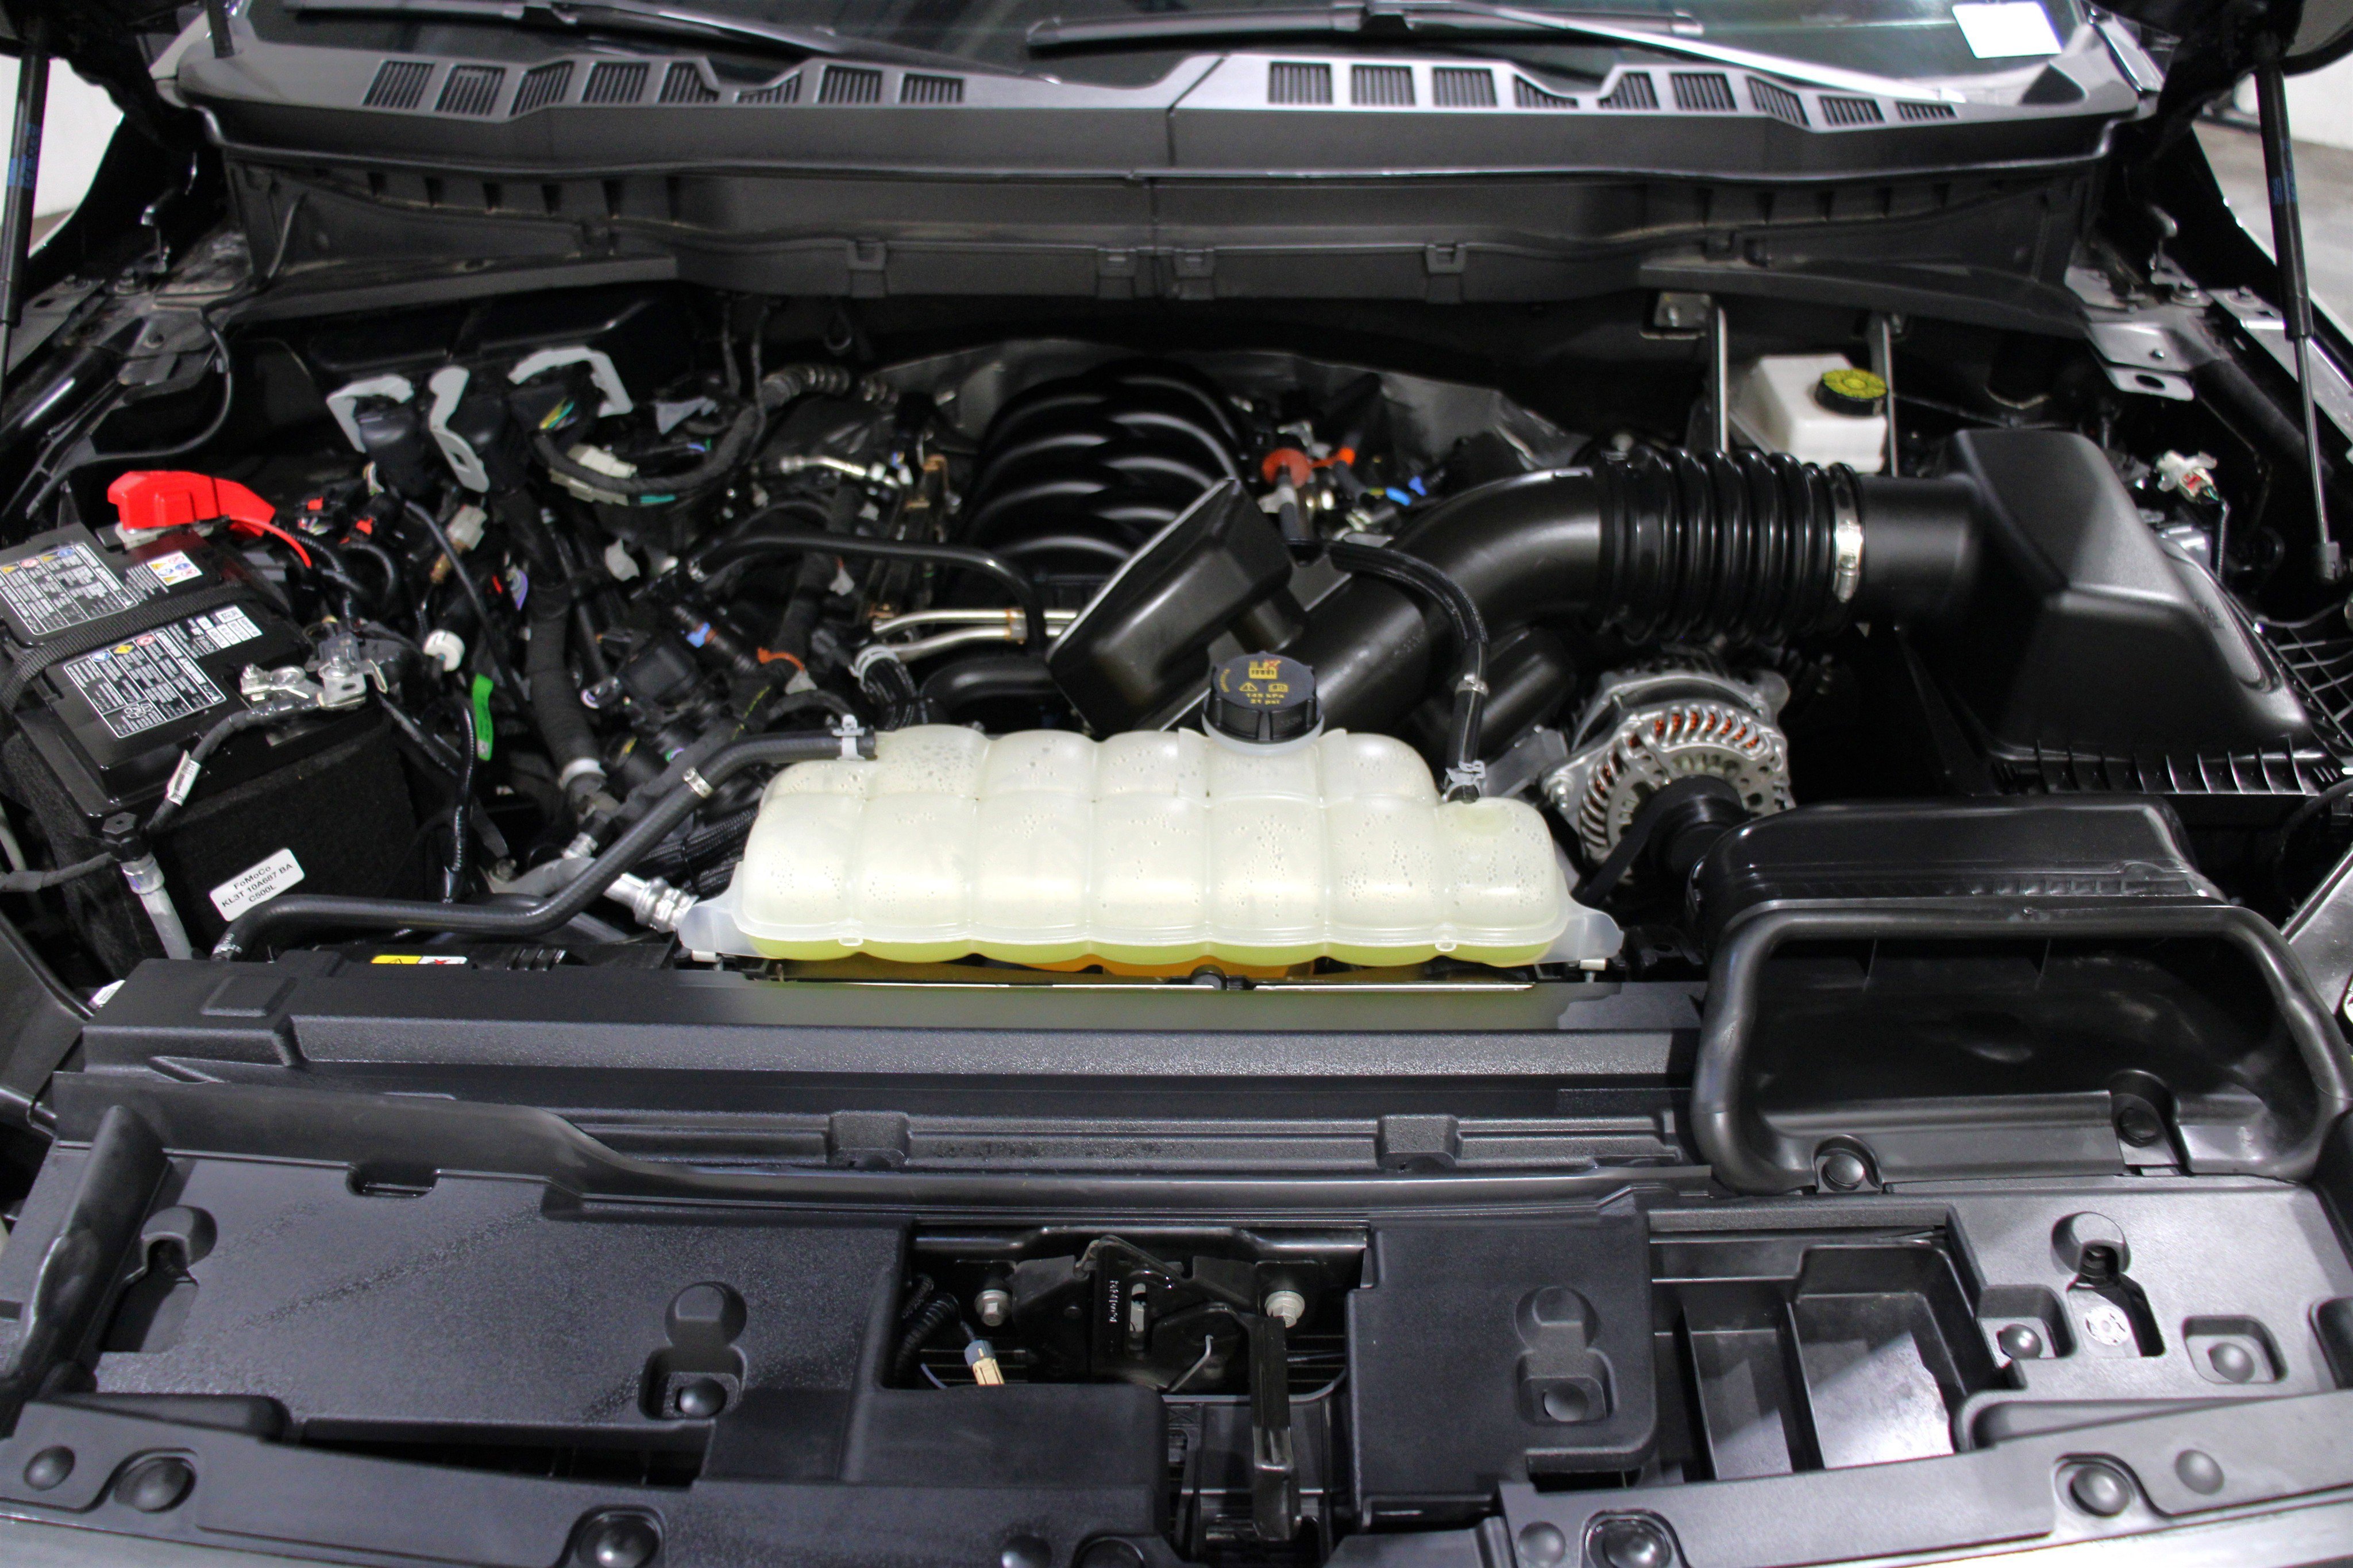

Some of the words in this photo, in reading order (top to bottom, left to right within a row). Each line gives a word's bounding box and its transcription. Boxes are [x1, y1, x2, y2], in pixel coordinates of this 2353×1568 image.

[222, 891, 245, 907] KL3T
[247, 872, 277, 893] 10A687
[279, 863, 293, 874] BA
[234, 866, 271, 889] FoMoCo
[249, 885, 276, 902] C500L
